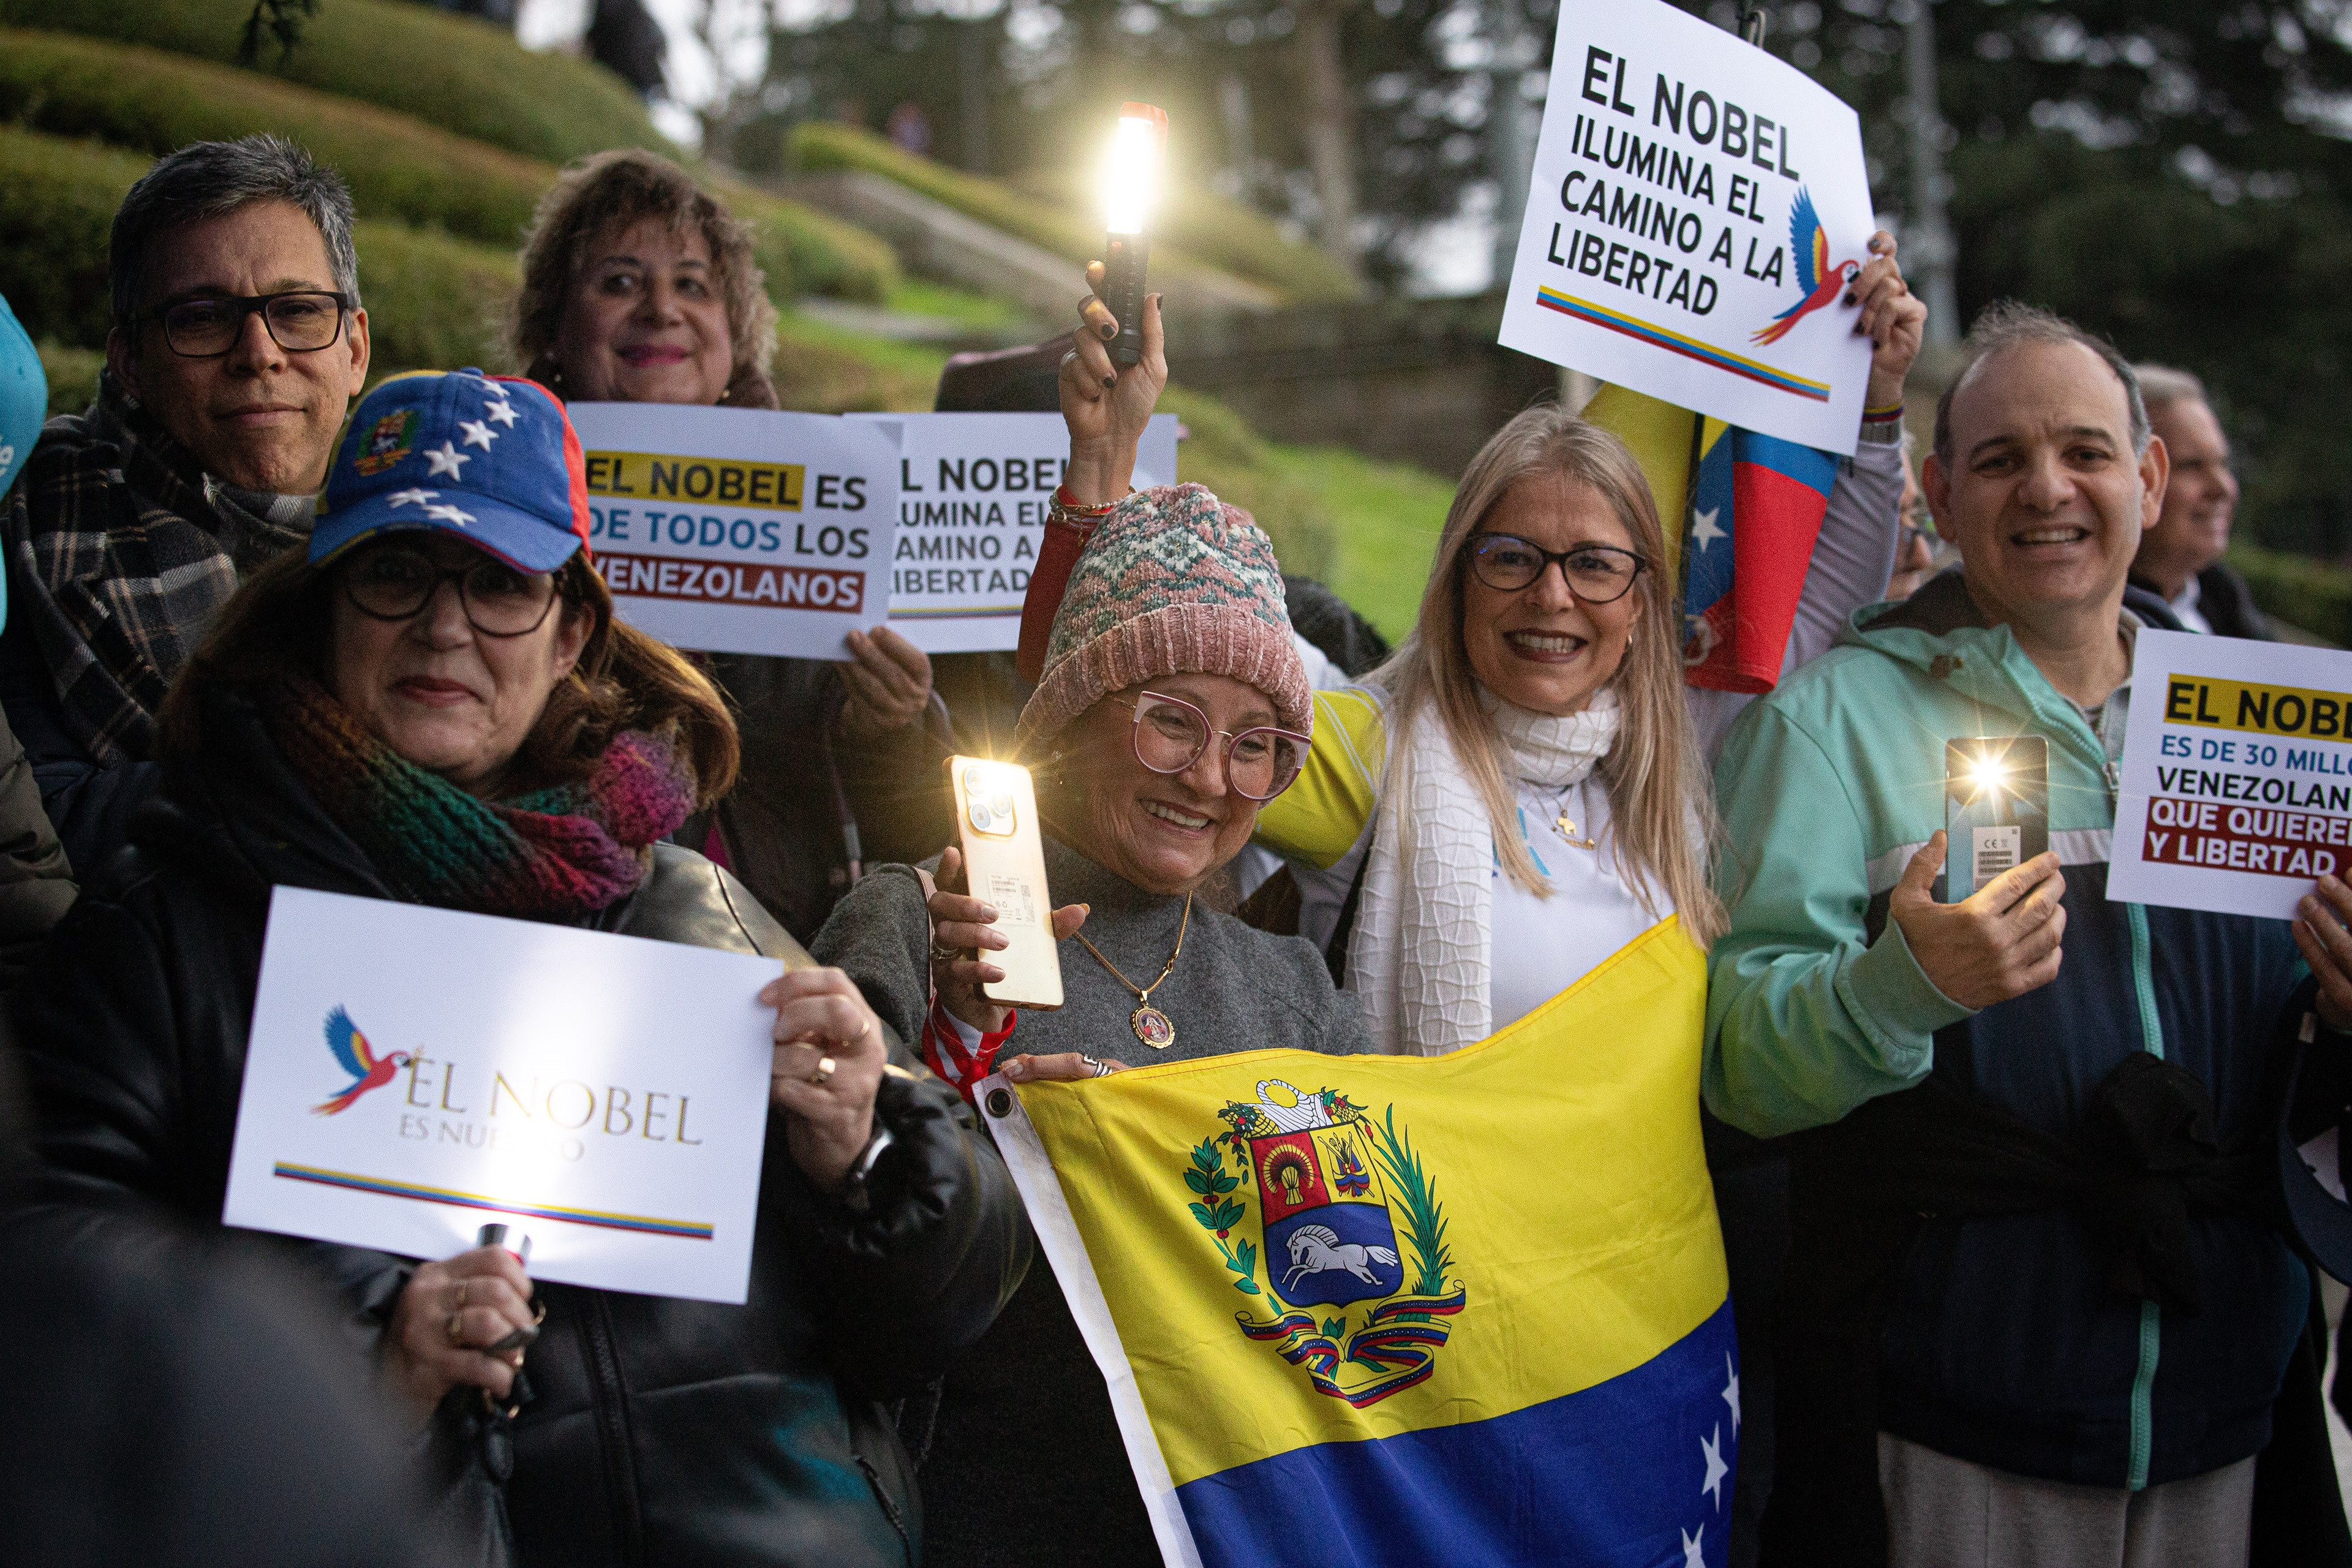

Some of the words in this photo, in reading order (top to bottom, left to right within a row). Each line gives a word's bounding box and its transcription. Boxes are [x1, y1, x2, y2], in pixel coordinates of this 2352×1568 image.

[1582, 45, 1635, 116] EL
[1652, 73, 1800, 182] NOBEL
[1571, 114, 1714, 206] ILUMINA
[1727, 173, 1764, 224] EL
[1561, 170, 1702, 254] CAMINO
[1709, 227, 1733, 268] A
[1743, 237, 1784, 287] LA
[1547, 222, 1718, 316] LIBERTAD
[586, 458, 633, 492] EL
[650, 461, 799, 506] NOBEL
[816, 475, 867, 511] ES
[902, 458, 923, 491] L
[645, 511, 780, 551] TODOS
[796, 524, 869, 558] LOS
[895, 501, 1005, 527] UMINA
[895, 535, 1001, 560] AMINO
[1014, 535, 1035, 560] A
[889, 569, 1031, 594] IBERTAD
[2168, 682, 2220, 724] EL
[2161, 735, 2192, 758] ES
[2201, 739, 2235, 763] DE
[2245, 744, 2277, 766] 30
[2286, 749, 2352, 775] MILL
[2157, 766, 2351, 812] VENEZOLAN
[2151, 799, 2220, 832] QUE
[2228, 807, 2352, 846] QUIERE
[2148, 831, 2170, 858] Y
[2177, 834, 2336, 877] LIBERTAD
[407, 1057, 466, 1114] EL
[489, 1070, 703, 1147] NOBEL
[400, 1113, 429, 1140] ES
